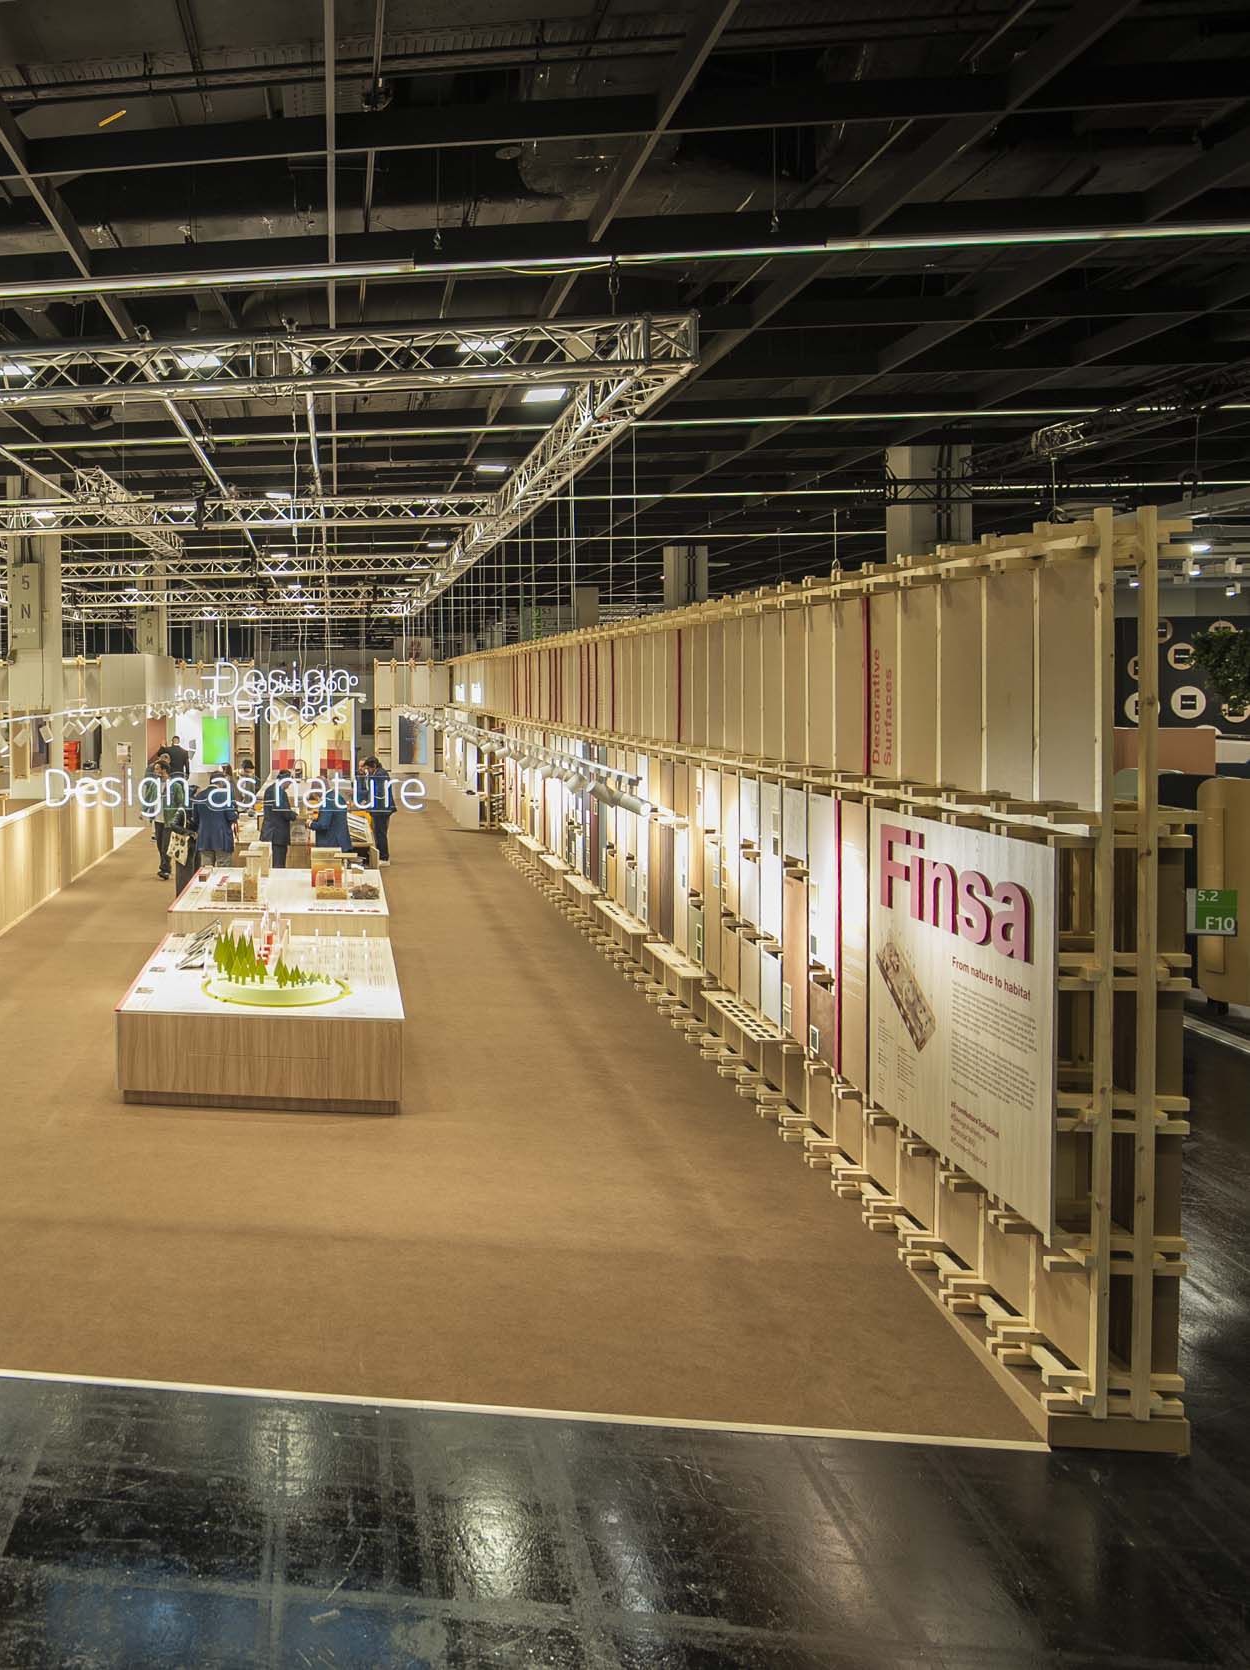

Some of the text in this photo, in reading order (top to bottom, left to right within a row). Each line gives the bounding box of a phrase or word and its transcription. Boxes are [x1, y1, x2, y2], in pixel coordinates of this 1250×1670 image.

[21, 575, 30, 590] 5
[21, 603, 31, 619] N
[873, 648, 881, 765] Decorative
[883, 668, 893, 767] Surfaces
[43, 767, 426, 817] Design as nature
[880, 823, 1034, 965] Finsa
[1197, 890, 1219, 902] 5.2
[1205, 916, 1236, 932] F10
[951, 955, 1031, 1002] From nature to habitat
